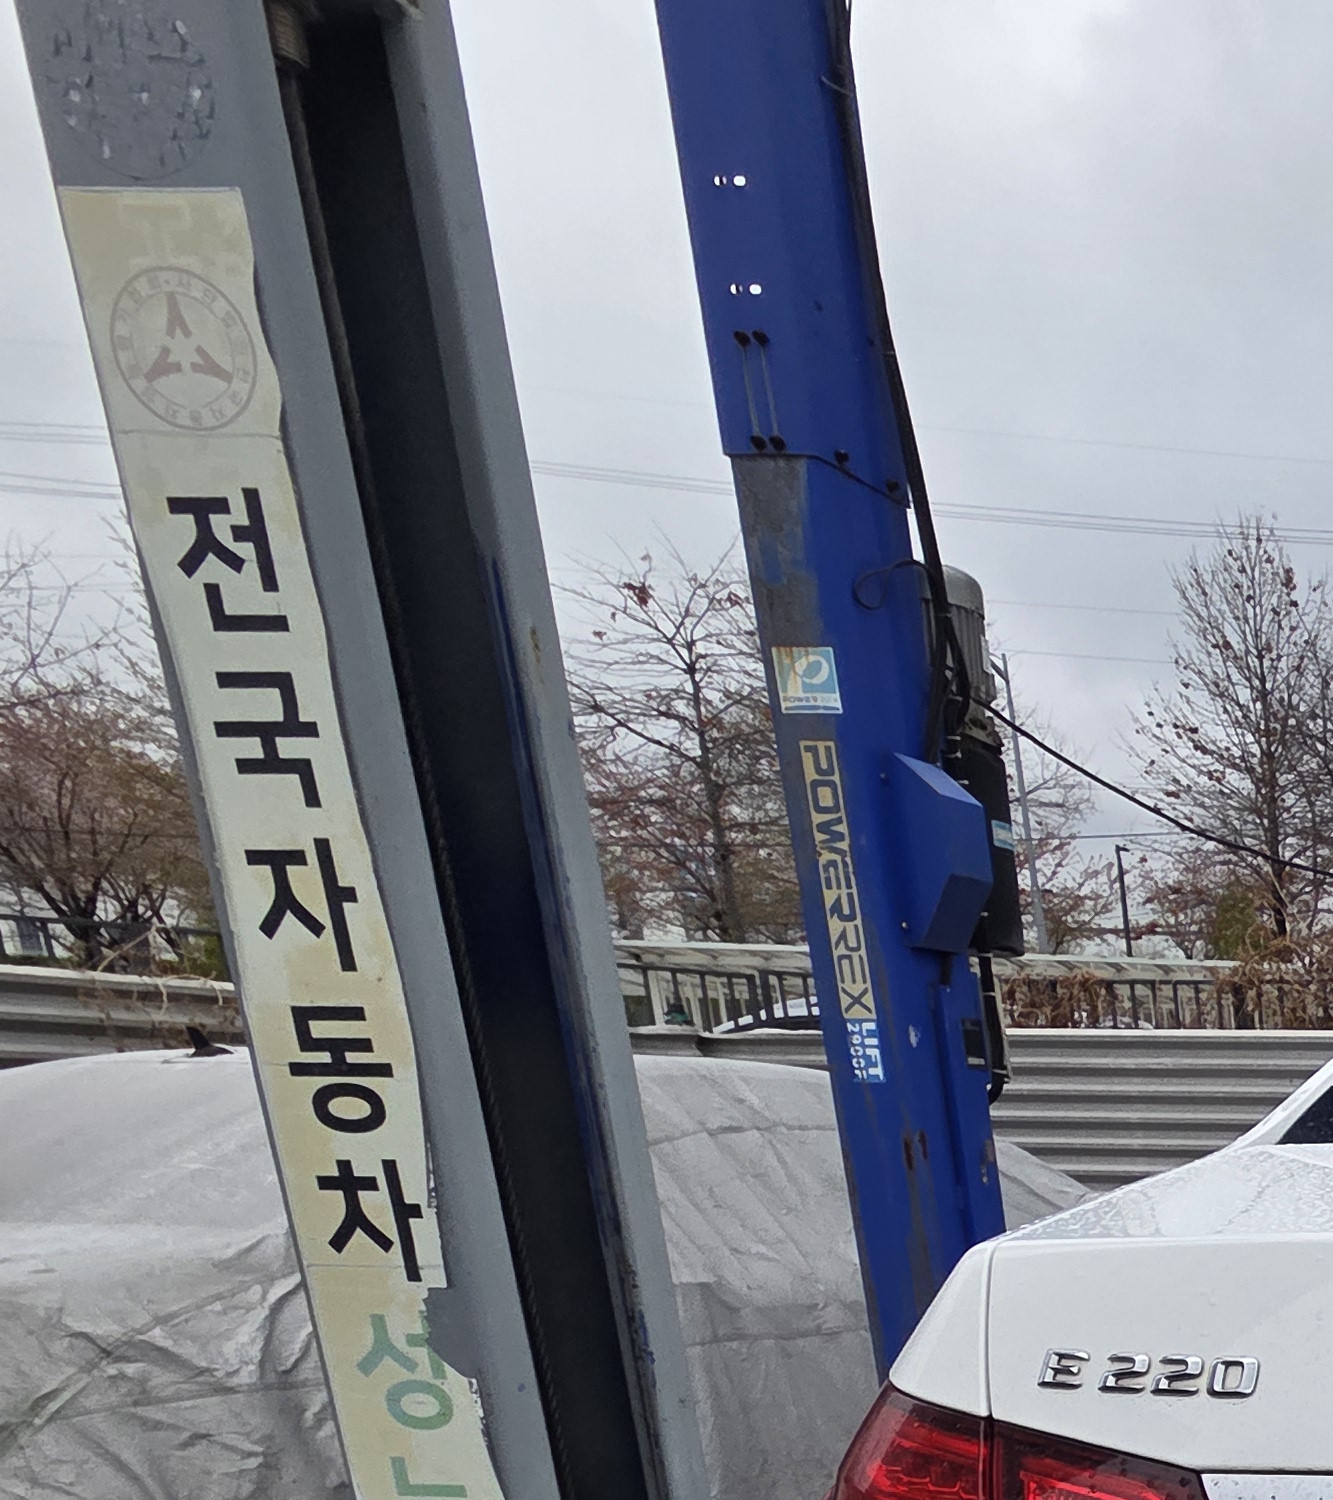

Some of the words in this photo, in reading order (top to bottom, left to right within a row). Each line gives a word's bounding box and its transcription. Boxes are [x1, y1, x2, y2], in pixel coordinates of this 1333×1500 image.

[862, 1022, 884, 1080] LIFT
[1038, 1348, 1090, 1389] E
[1098, 1352, 1261, 1399] 220
